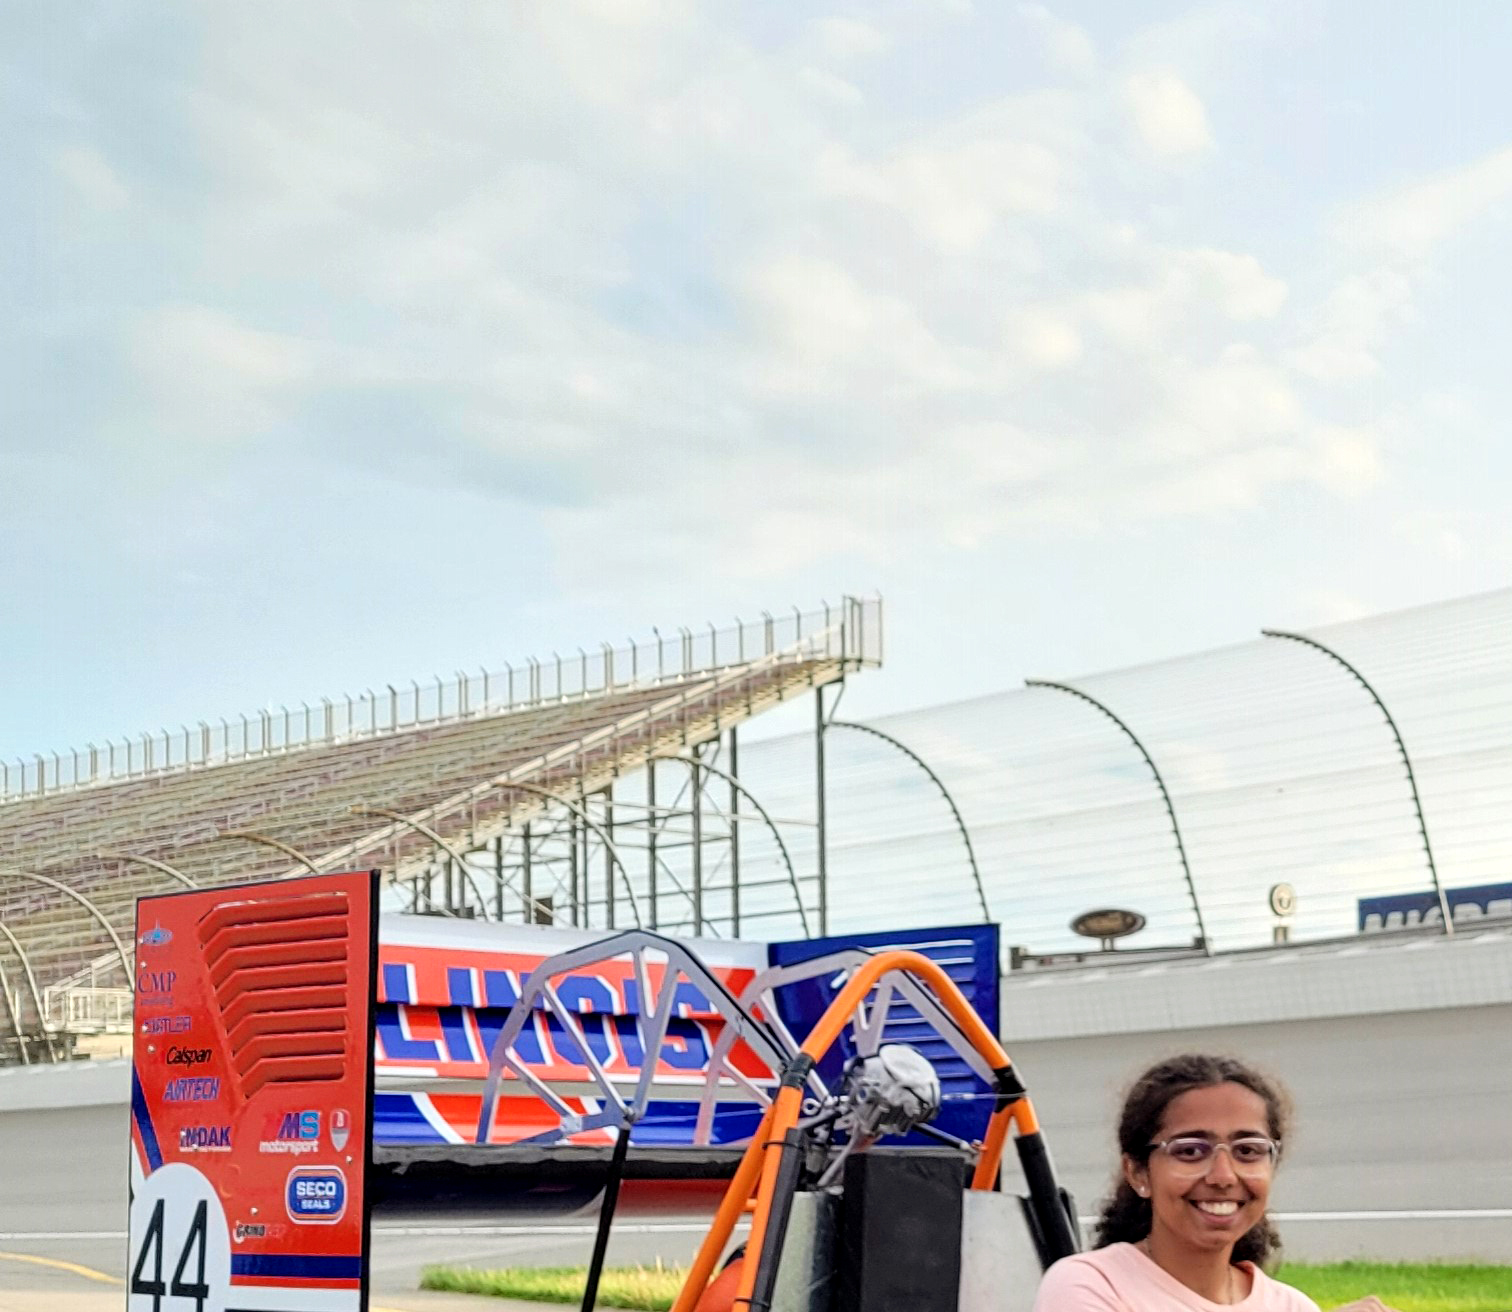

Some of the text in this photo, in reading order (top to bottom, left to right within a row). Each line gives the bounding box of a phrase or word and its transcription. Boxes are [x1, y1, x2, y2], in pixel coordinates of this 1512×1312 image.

[138, 971, 176, 992] CMP
[167, 1046, 212, 1067] Calspan
[278, 1111, 319, 1139] MS
[296, 1182, 336, 1196] SECO
[302, 1200, 331, 1209] SEALS
